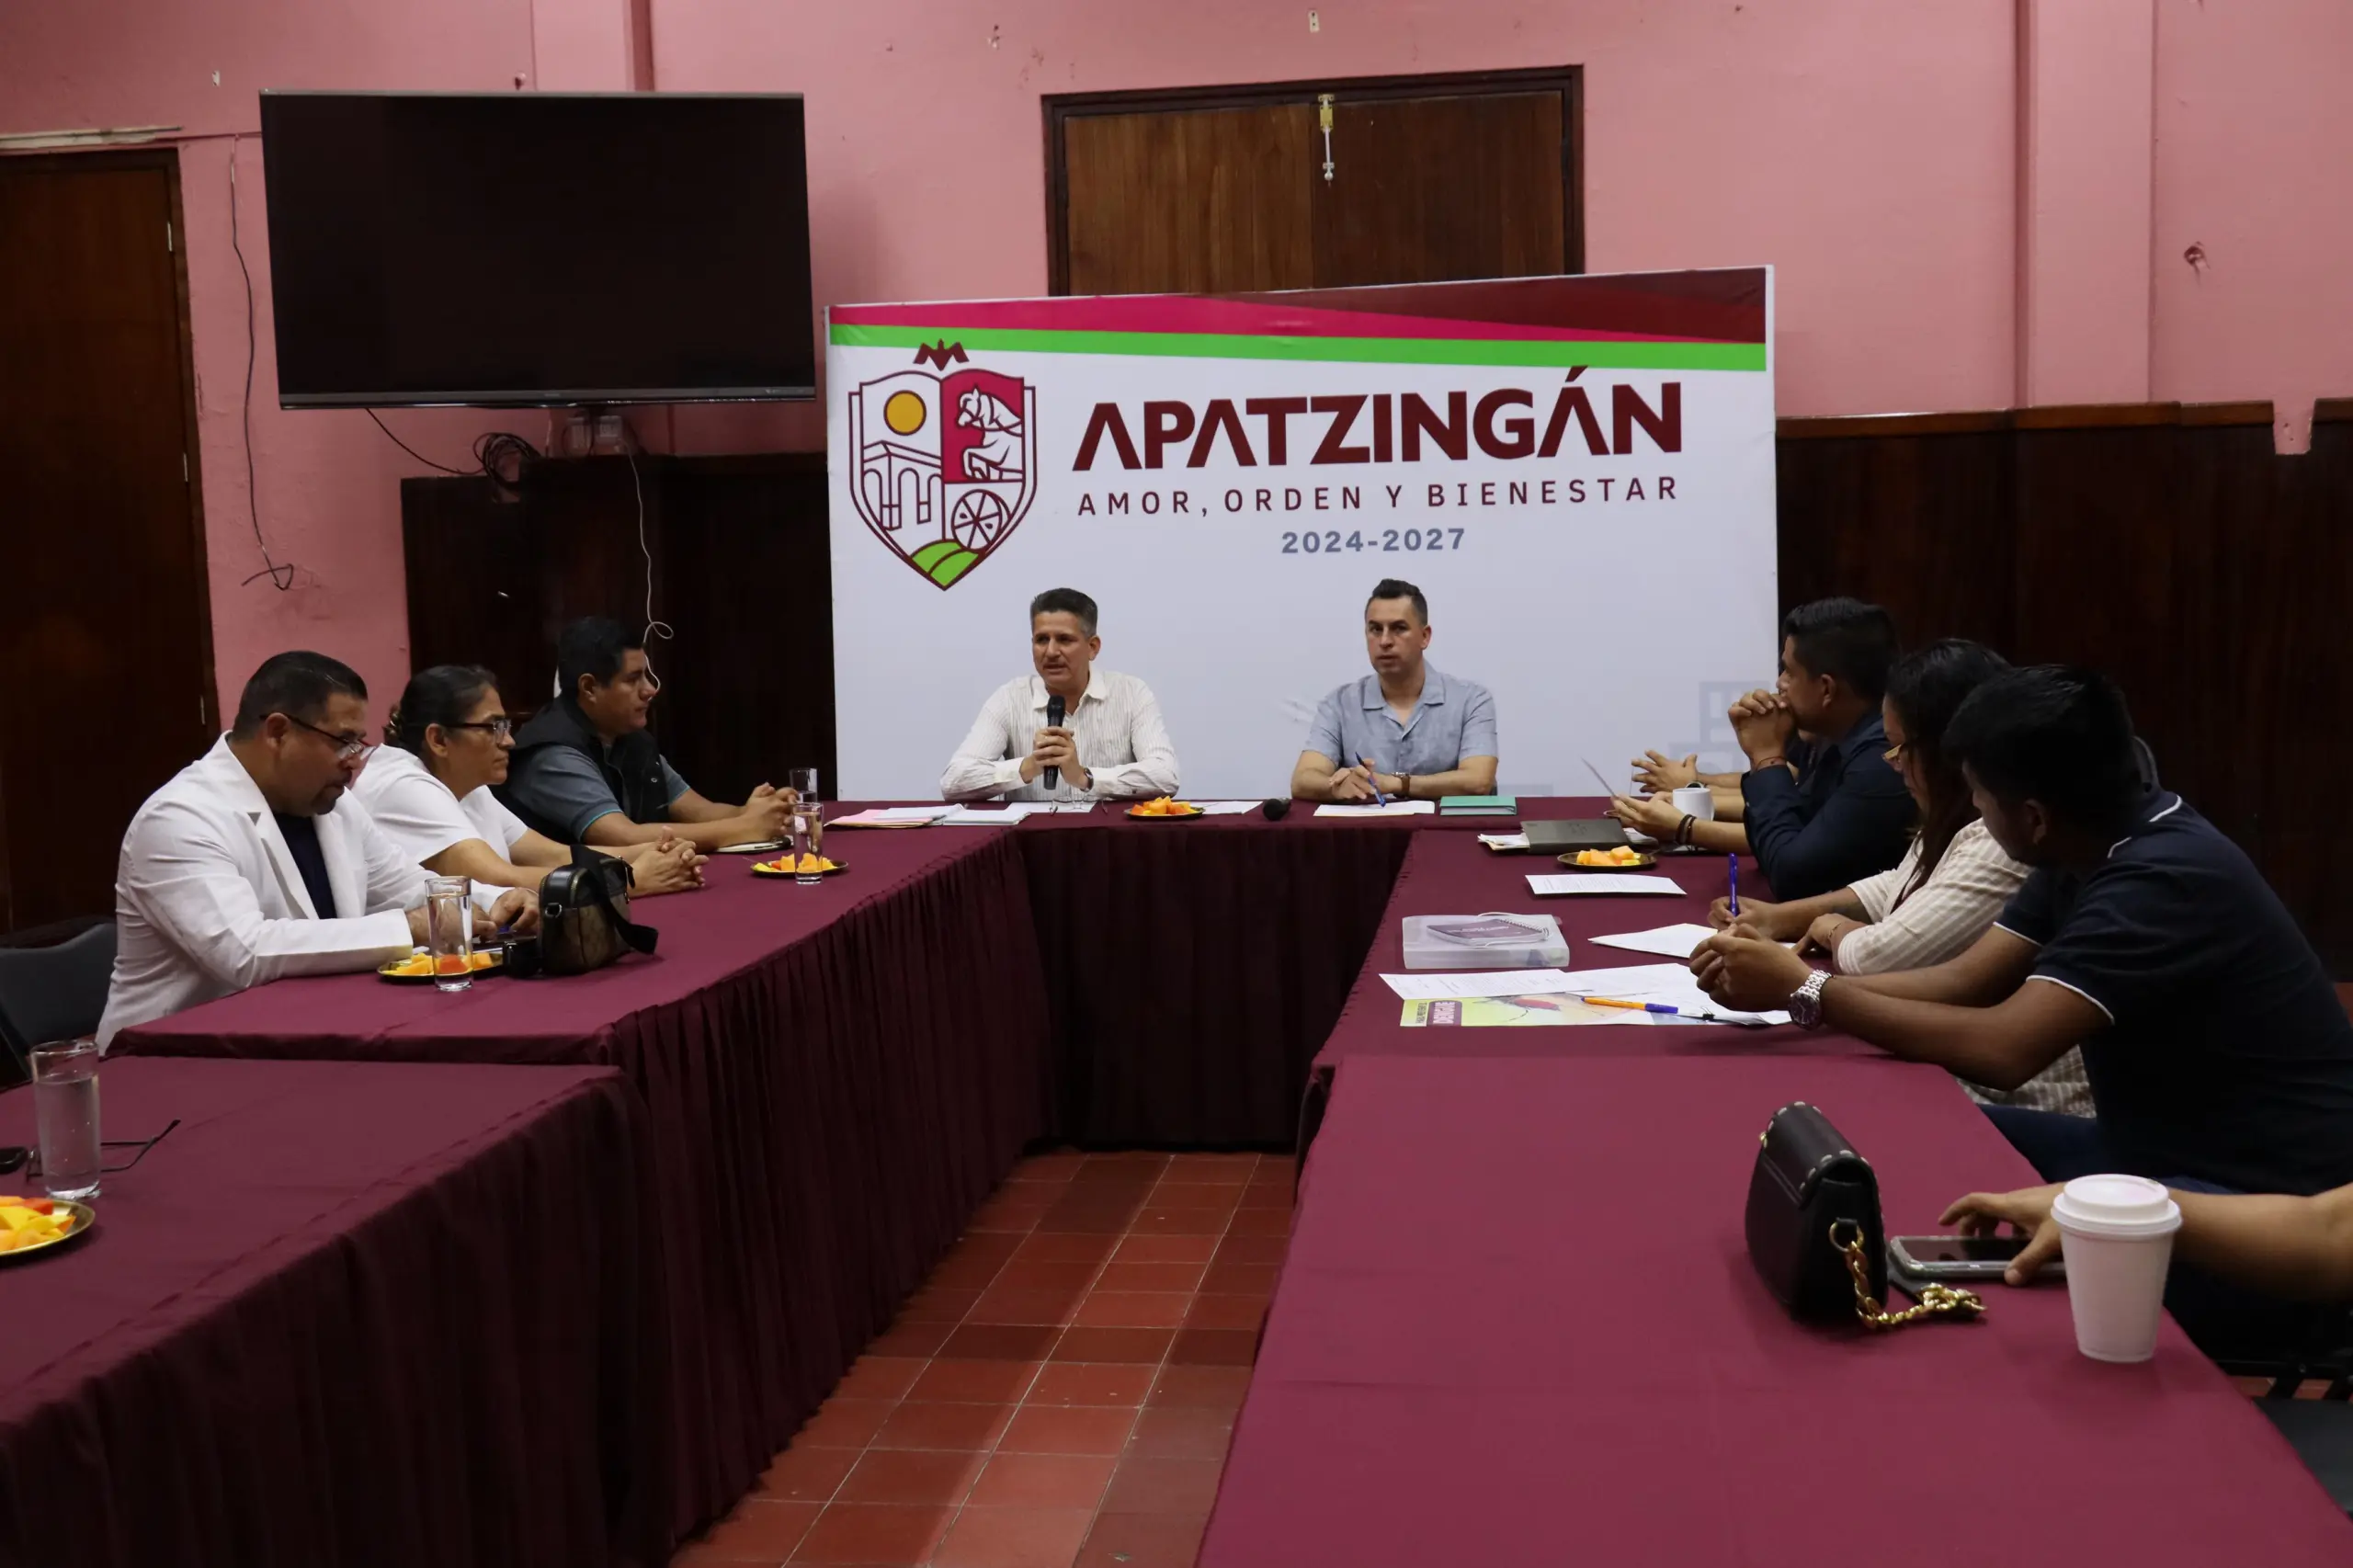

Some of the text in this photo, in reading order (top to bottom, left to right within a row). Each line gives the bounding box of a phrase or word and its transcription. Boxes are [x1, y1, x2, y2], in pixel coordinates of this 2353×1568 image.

[1072, 364, 1682, 472] APATZINGÁN
[1077, 475, 1677, 517] AMOR, ORDEN Y BIENESTAR
[1281, 528, 1466, 554] 2024-2027
